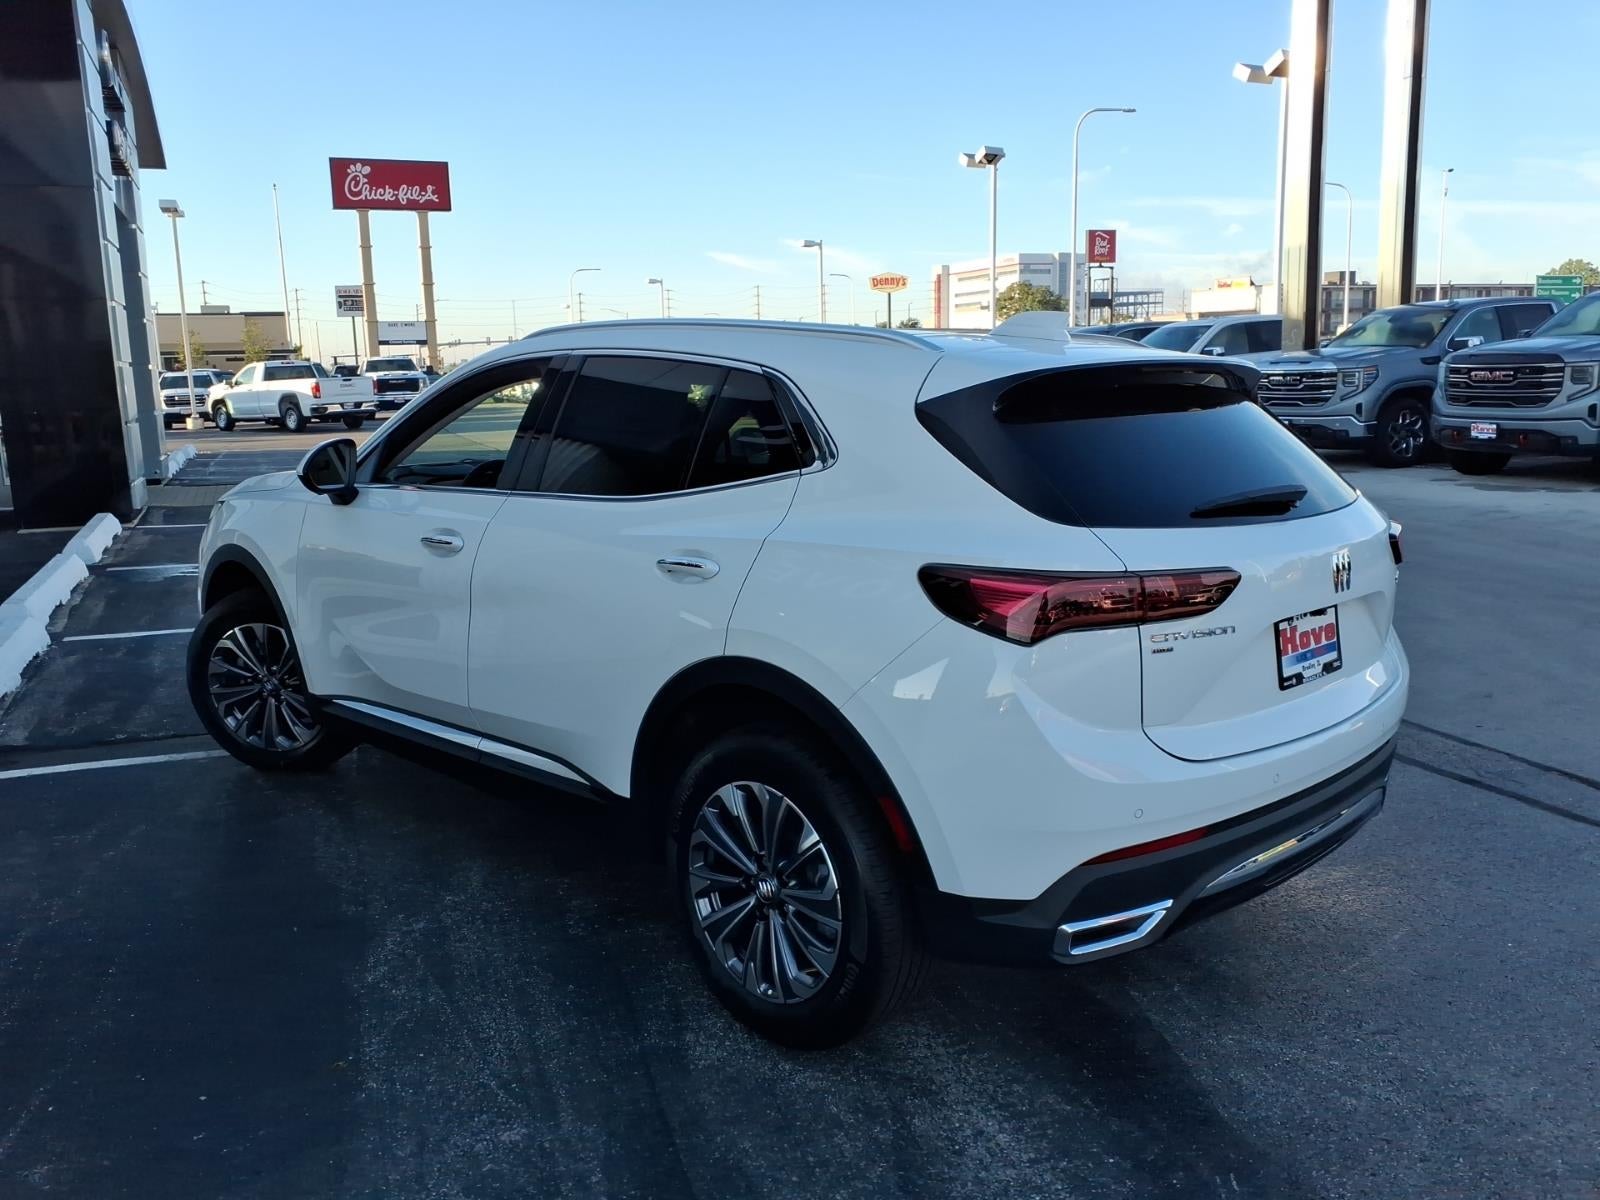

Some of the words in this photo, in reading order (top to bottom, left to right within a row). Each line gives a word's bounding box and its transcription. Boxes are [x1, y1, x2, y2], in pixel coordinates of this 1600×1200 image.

[345, 170, 439, 204] Chick-fil-A
[1096, 237, 1108, 246] Red
[1095, 245, 1110, 256] Roof
[871, 276, 908, 288] Denny's
[1269, 376, 1300, 385] GMC
[1471, 371, 1514, 381] GMC
